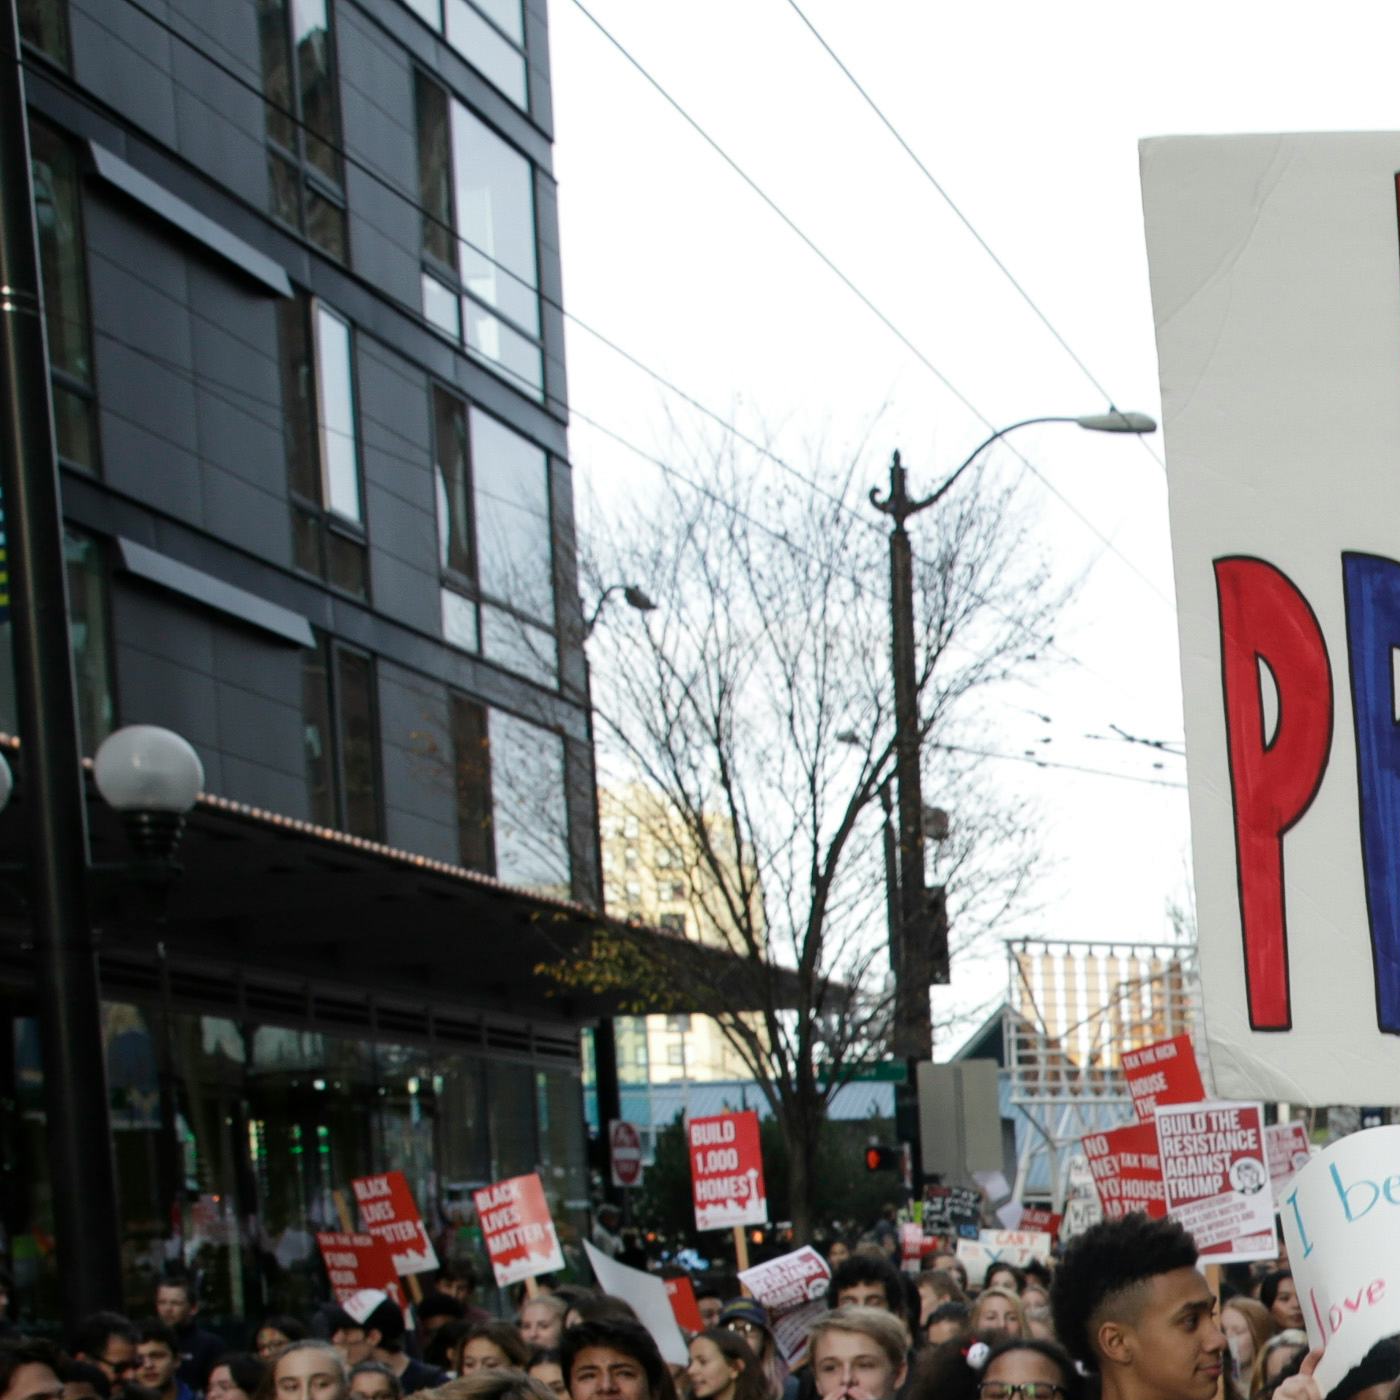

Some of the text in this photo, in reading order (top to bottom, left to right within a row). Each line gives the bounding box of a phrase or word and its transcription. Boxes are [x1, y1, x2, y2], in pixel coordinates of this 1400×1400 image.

[1123, 1053, 1141, 1069] TAX
[1140, 1048, 1155, 1063] THE
[1131, 1072, 1168, 1096] HOUSE
[690, 1120, 736, 1146] BUILD
[1160, 1110, 1240, 1137] BUILD THE
[1084, 1136, 1109, 1158] NO
[1162, 1129, 1258, 1157] RESISTANCE
[696, 1148, 738, 1173] 1,000
[1166, 1153, 1232, 1178] AGAINST
[353, 1176, 392, 1200] BLACK
[474, 1182, 522, 1211] BLACK
[696, 1177, 749, 1201] HOMES
[1122, 1179, 1164, 1200] HOUSE
[1168, 1175, 1223, 1200] TRUMP
[360, 1202, 396, 1223] LIVES
[481, 1206, 521, 1234] LIVES
[1286, 1187, 1314, 1259] I
[487, 1222, 544, 1253] MATTER
[1309, 1279, 1386, 1347] love
